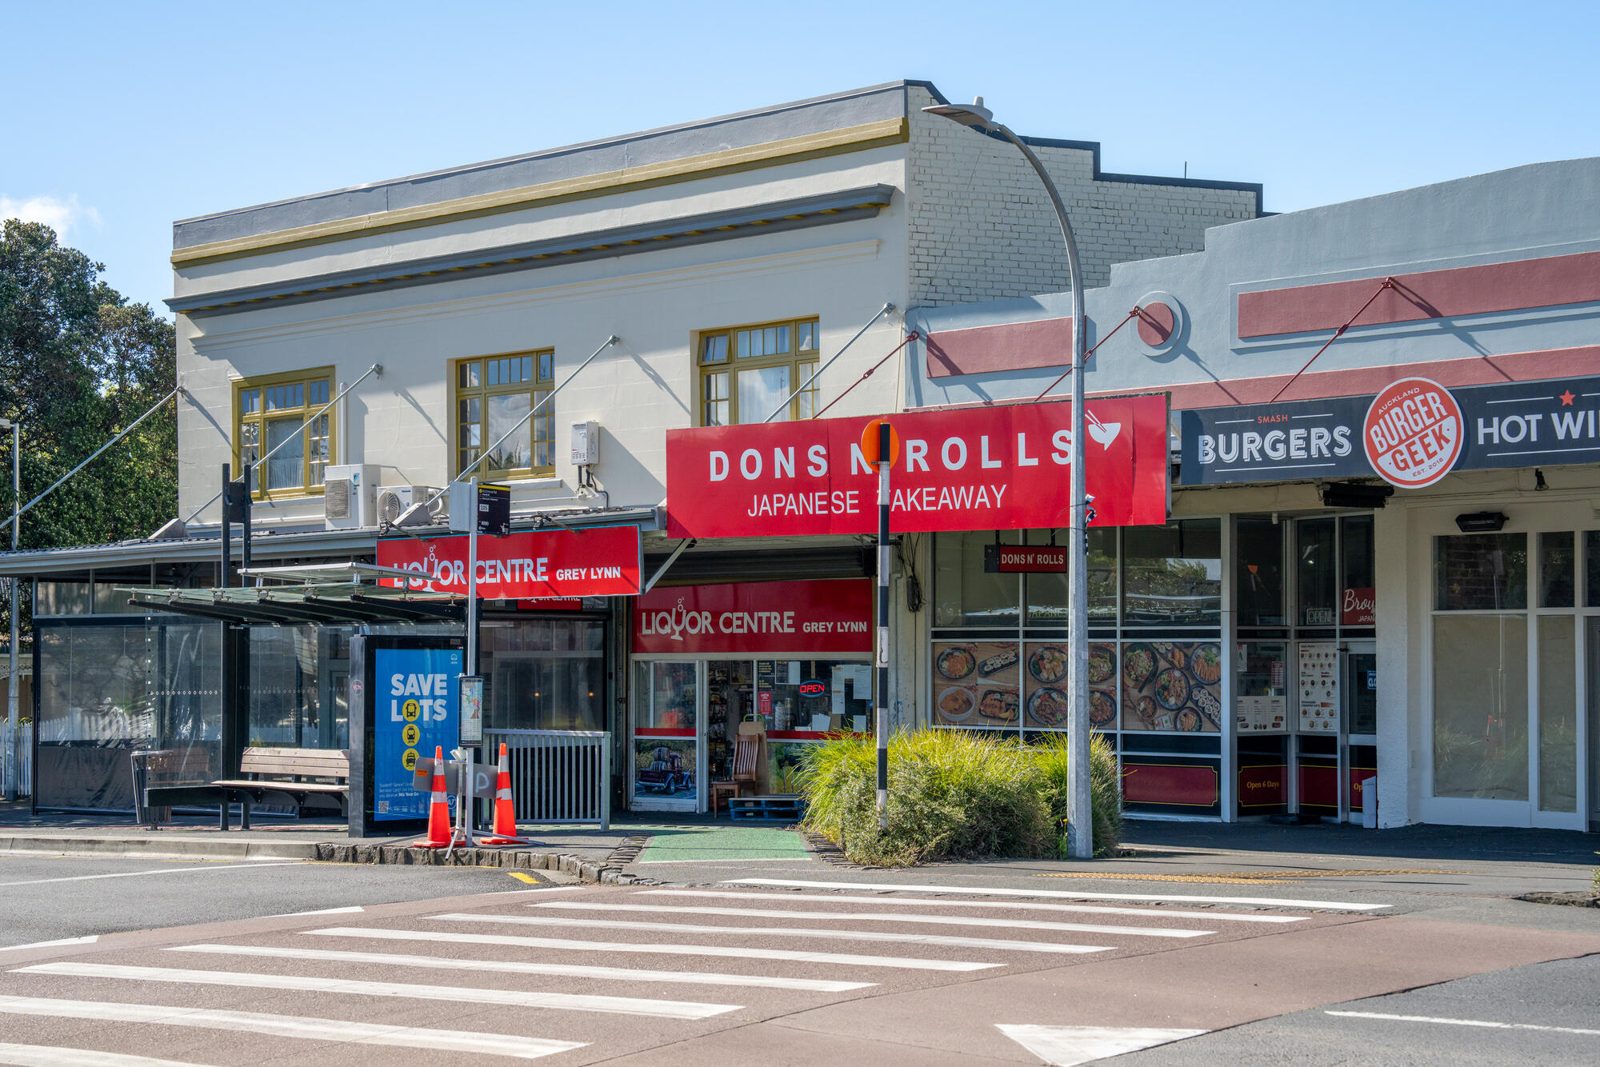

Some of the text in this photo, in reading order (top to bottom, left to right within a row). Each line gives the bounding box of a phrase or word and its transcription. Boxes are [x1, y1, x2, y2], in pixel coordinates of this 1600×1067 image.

[1378, 387, 1420, 415] AUCKLAND
[1257, 414, 1288, 424] SMASH
[1370, 391, 1448, 454] BURGER
[1477, 410, 1600, 445] HOT WI
[709, 444, 828, 482] DONS
[906, 429, 1071, 473] ROLLS
[1198, 425, 1352, 464] BURGERS
[1391, 423, 1451, 472] GEEK
[748, 484, 1007, 517] JAPANESE AKEAWAY
[475, 557, 549, 584] CENTRE
[556, 568, 587, 581] GREY
[590, 566, 621, 580] LYNN
[1001, 553, 1064, 565] DONS N' ROLLS
[642, 608, 868, 641] LIQUOR CENTRE GREY LYNN
[390, 673, 448, 696] SAVE
[800, 684, 825, 693] OPEN
[1246, 780, 1262, 791] Open
